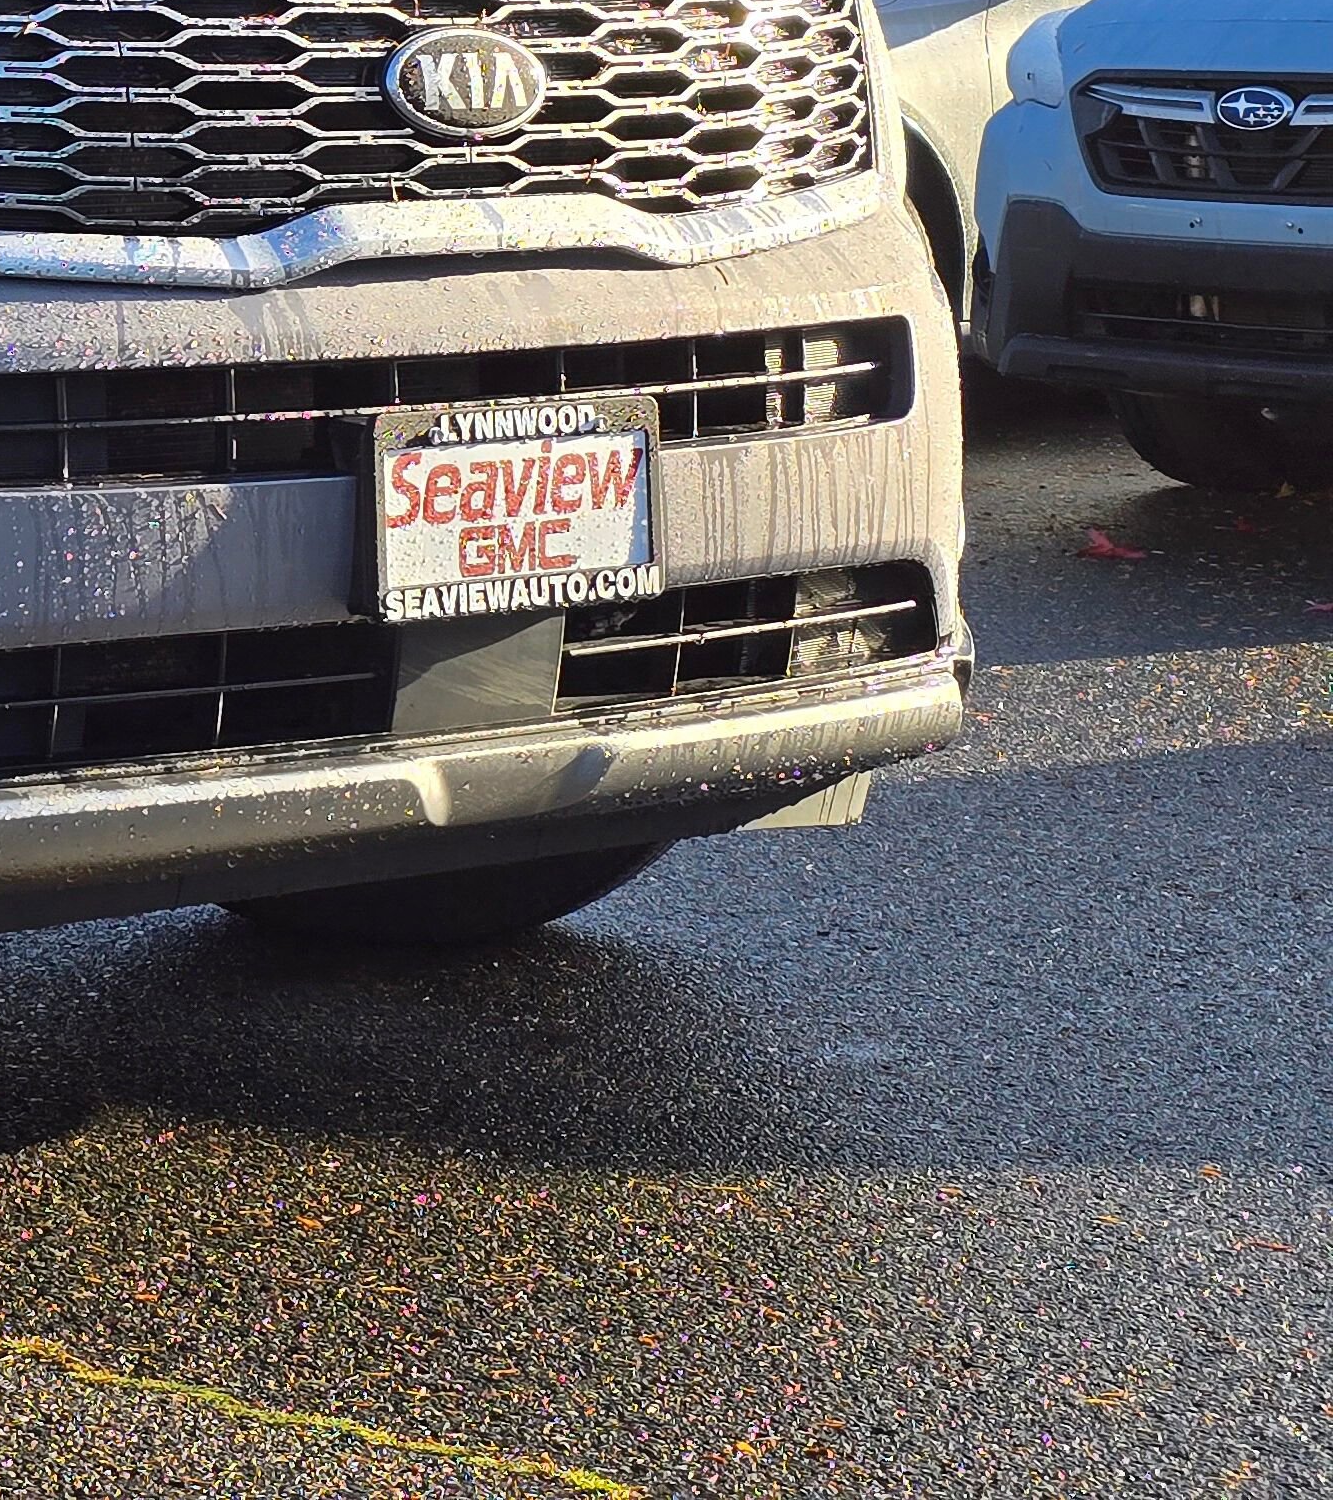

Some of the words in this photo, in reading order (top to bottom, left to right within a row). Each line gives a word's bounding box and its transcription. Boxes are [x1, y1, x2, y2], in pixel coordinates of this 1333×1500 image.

[415, 51, 529, 111] KIA
[439, 404, 597, 442] LYNNWOOD
[386, 439, 644, 529] Seaview
[459, 518, 578, 578] GMC
[386, 563, 661, 622] SEAVIEWAUTO.COM
